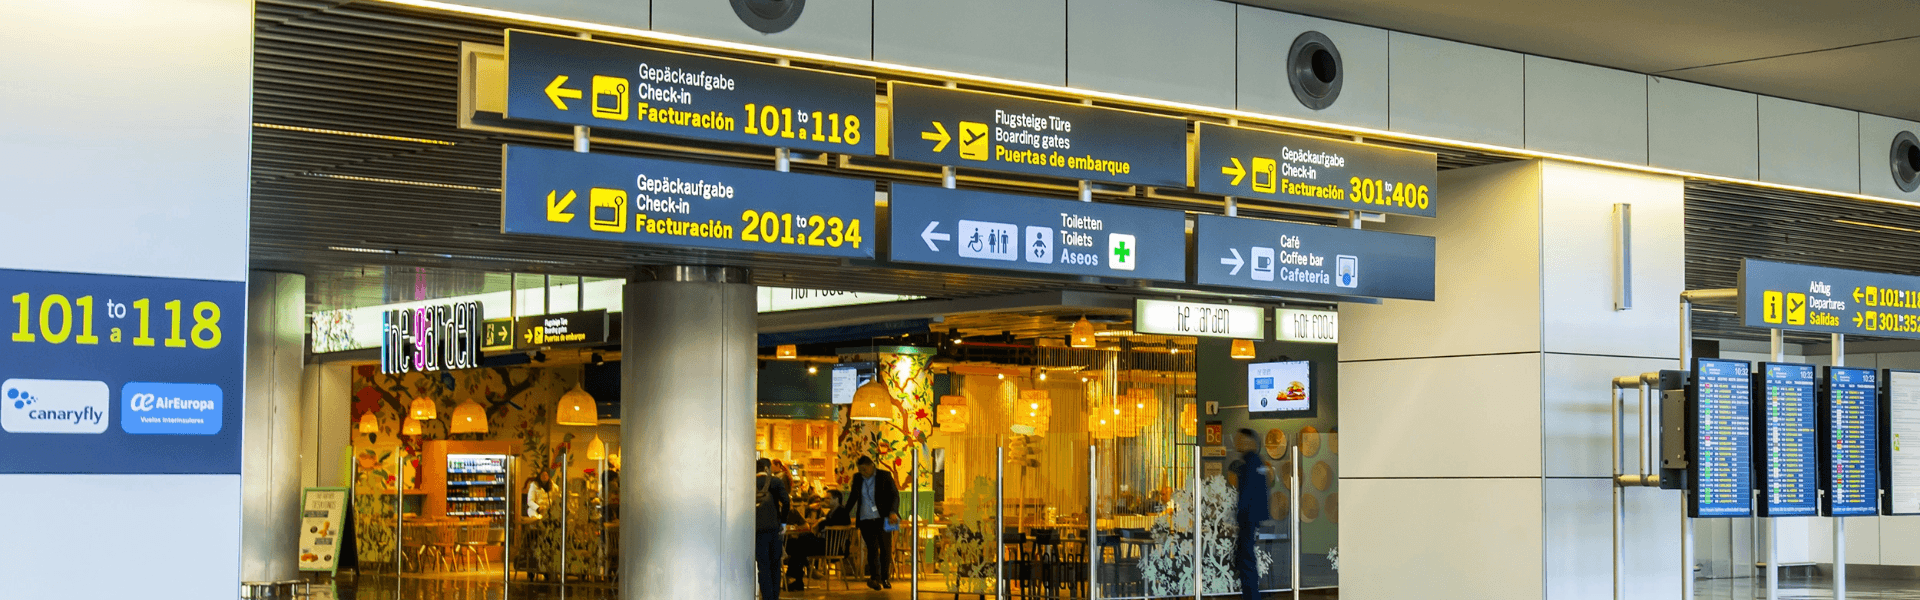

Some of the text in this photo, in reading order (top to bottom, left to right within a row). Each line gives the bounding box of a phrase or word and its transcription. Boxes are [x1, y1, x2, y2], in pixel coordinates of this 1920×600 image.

[638, 63, 735, 91] Gepäckaufgabe
[638, 83, 691, 105] Check-in
[638, 102, 734, 131] Facturación
[744, 103, 861, 145] 101 to a 118
[995, 109, 1071, 132] Flugsteige Türe
[995, 127, 1070, 150] Boarding gates
[995, 145, 1130, 176] Puertas de embarque
[1282, 146, 1345, 168] Gepäckaufgabe
[1282, 162, 1316, 180] Check-in
[636, 174, 734, 199] Gepäckaufgabe
[1281, 178, 1345, 200] Facturación
[1349, 176, 1385, 205] 301
[1385, 181, 1393, 192] to
[1392, 182, 1429, 210] 406
[636, 194, 690, 215] Check-in
[636, 214, 733, 239] Facturación
[741, 209, 862, 249] 201 to a 234
[1061, 213, 1102, 231] Toiletten
[1061, 230, 1093, 247] Toilets
[1280, 234, 1300, 249] Café
[1061, 248, 1098, 266] Aseos
[1280, 250, 1324, 266] Coffee bar
[1280, 266, 1330, 284] Cafetería
[1809, 280, 1831, 297] Abflug
[1879, 288, 1900, 308] 101
[1809, 296, 1846, 311] Departures
[12, 292, 222, 349] 101 to a 118
[1293, 313, 1334, 339] hot food
[1809, 311, 1840, 326] Salidas
[1879, 312, 1900, 332] 301
[414, 300, 479, 373] garden
[1735, 367, 1749, 376] 10:32
[1800, 371, 1813, 379] 10:32
[1863, 374, 1875, 383] 10:32
[28, 406, 103, 424] canaryfly
